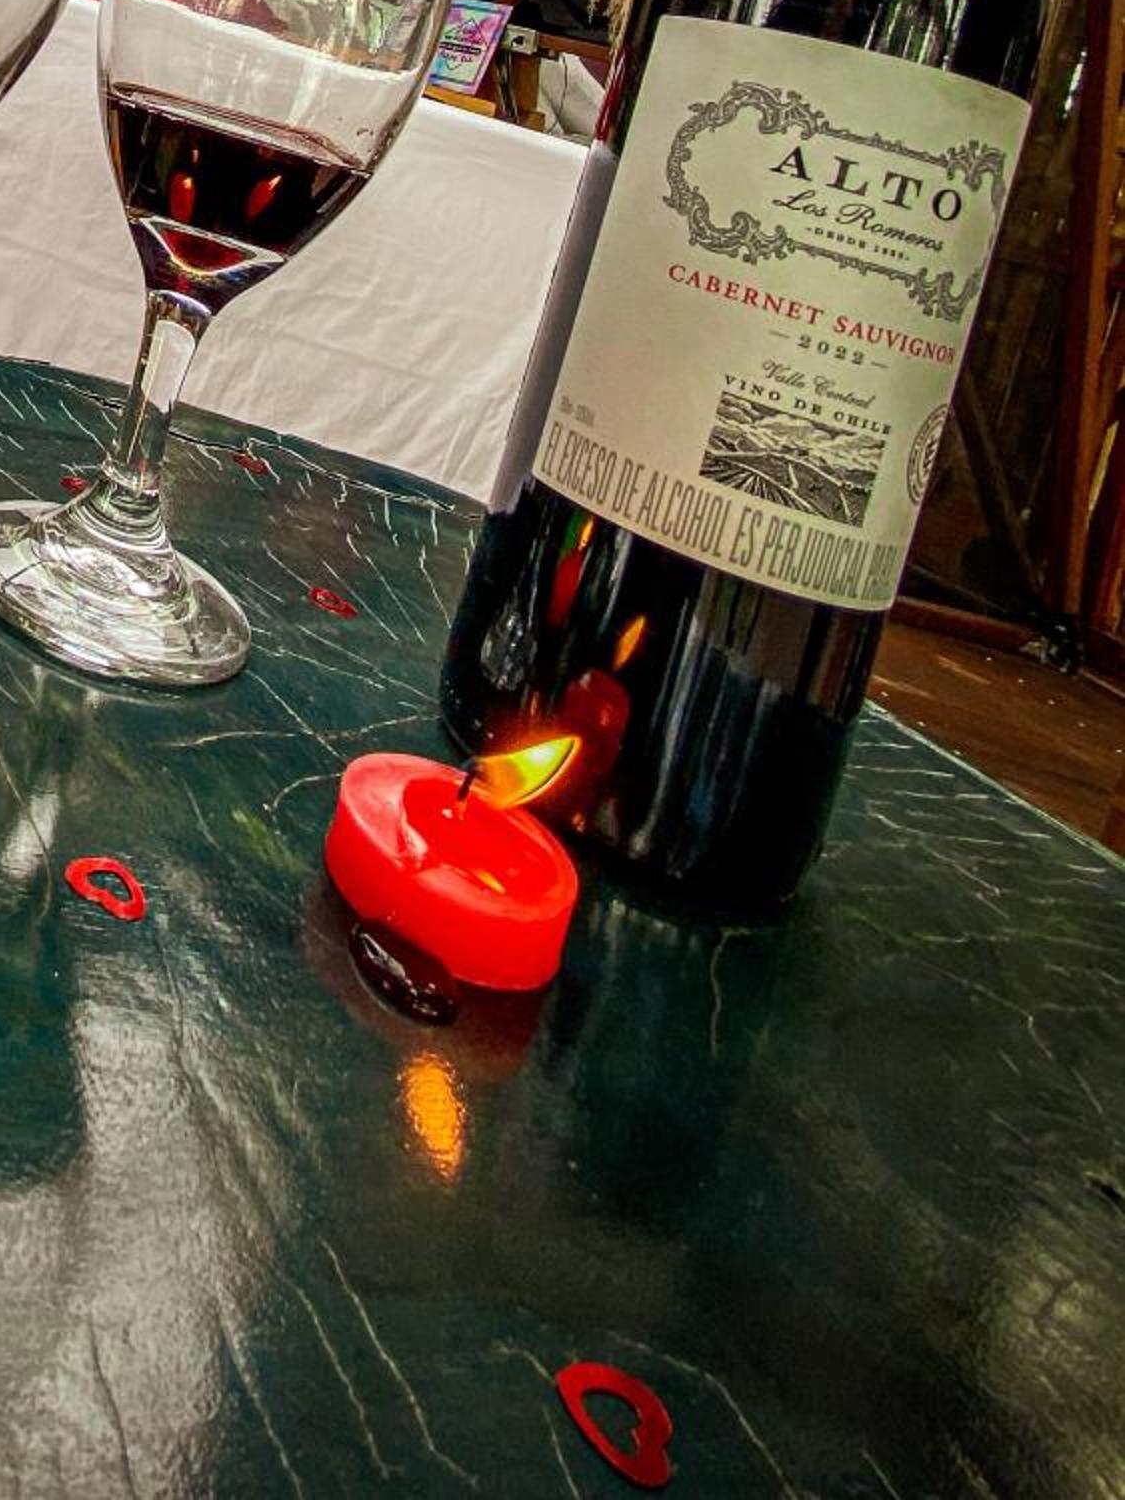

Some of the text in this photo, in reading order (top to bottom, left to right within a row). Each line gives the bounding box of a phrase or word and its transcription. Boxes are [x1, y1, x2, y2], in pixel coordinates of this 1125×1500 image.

[769, 146, 962, 221] ALTO
[772, 190, 944, 251] Los Romeros
[668, 264, 824, 325] CABERNET
[797, 334, 865, 365] 2022
[725, 374, 891, 435] VINO DE CHILE
[541, 421, 563, 477] EL
[556, 430, 618, 504] EXCESO
[611, 457, 645, 519] DE
[637, 470, 732, 558] ALCOHOL
[728, 505, 763, 567] ES
[757, 515, 869, 599] PERJUDICIAL
